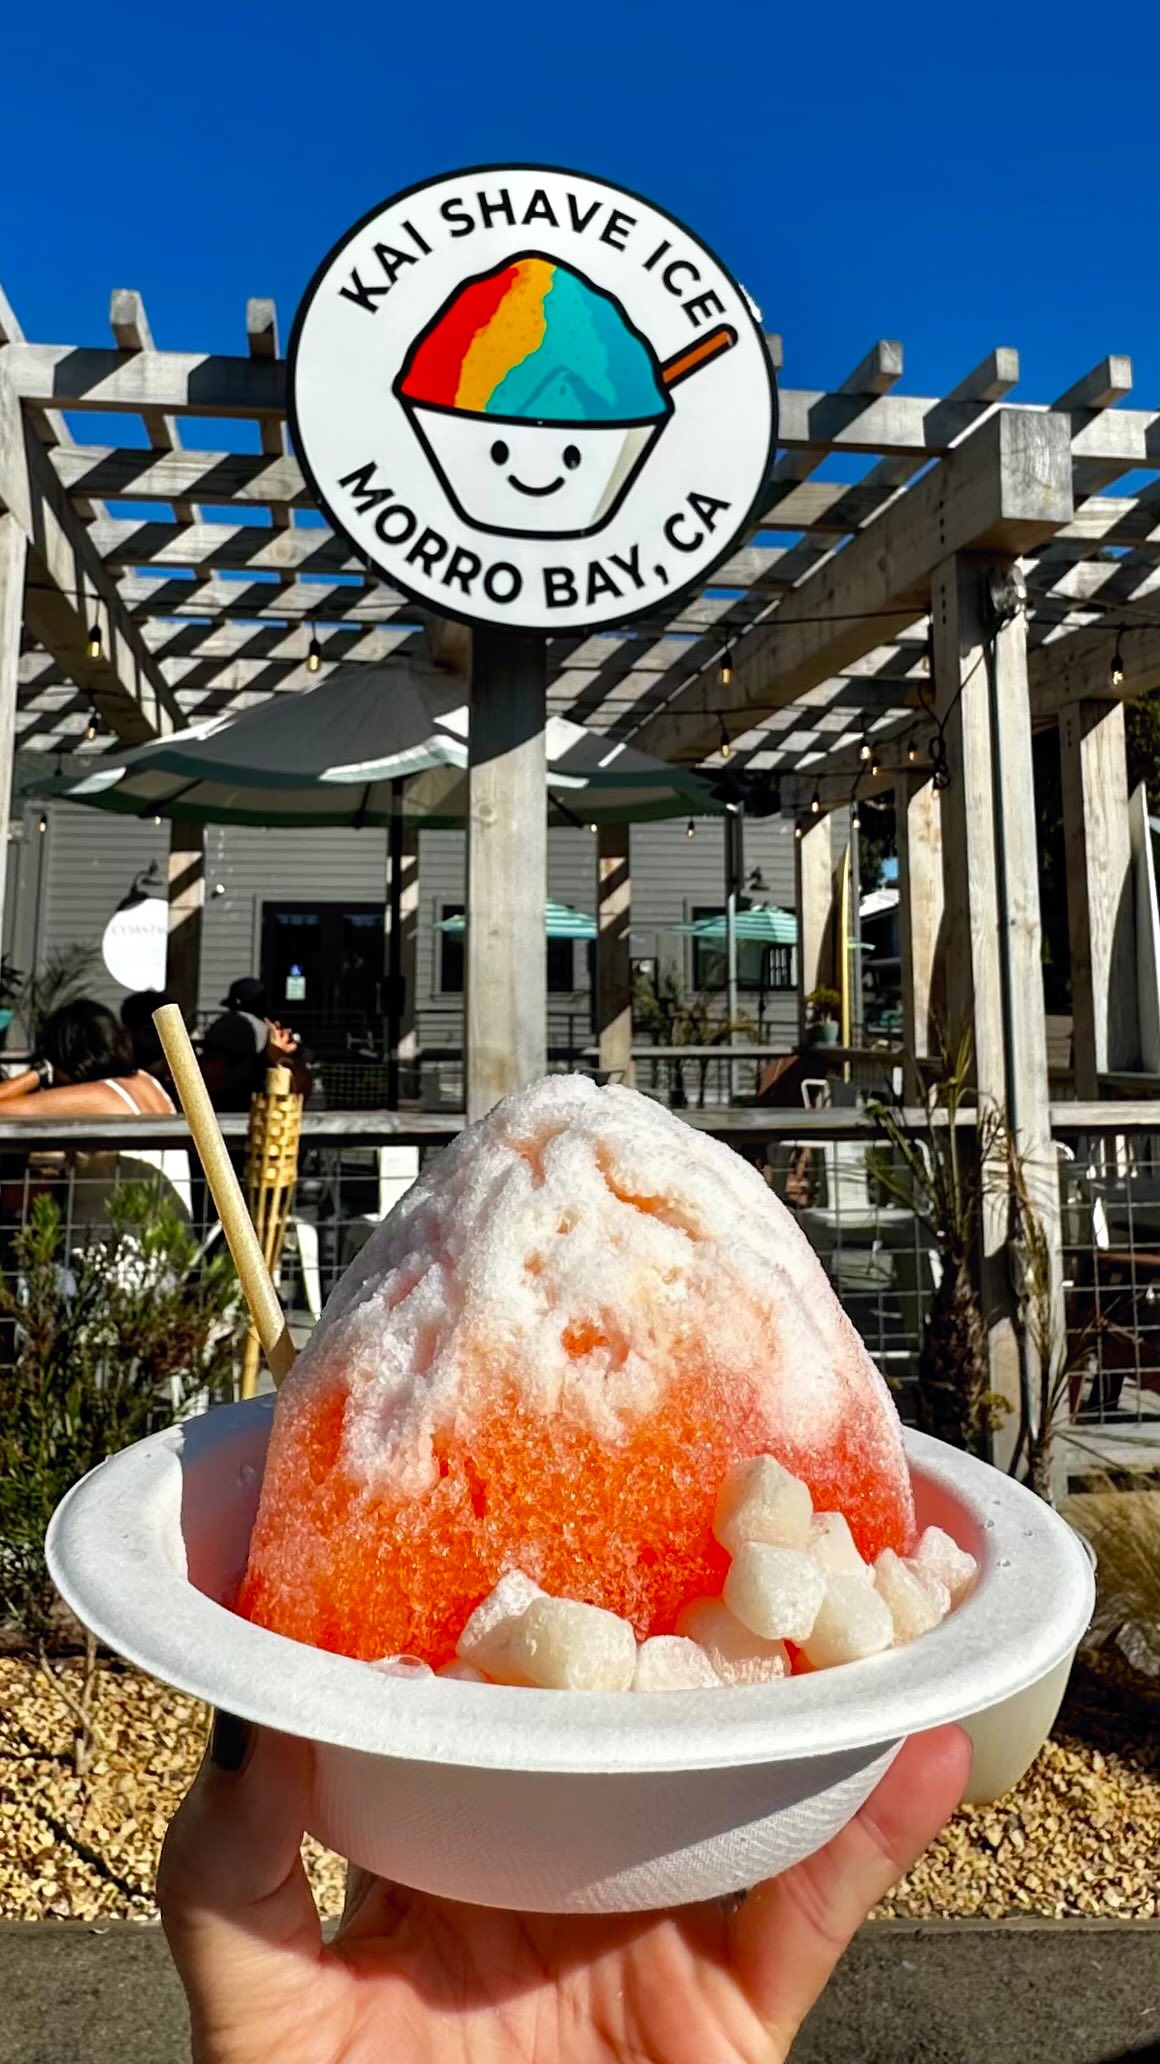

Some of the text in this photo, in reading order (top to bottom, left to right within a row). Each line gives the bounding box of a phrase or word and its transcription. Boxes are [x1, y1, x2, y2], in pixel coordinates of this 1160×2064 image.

[338, 188, 727, 328] KAI SHAVE ICE
[338, 461, 732, 609] MORRO BAY, CA
